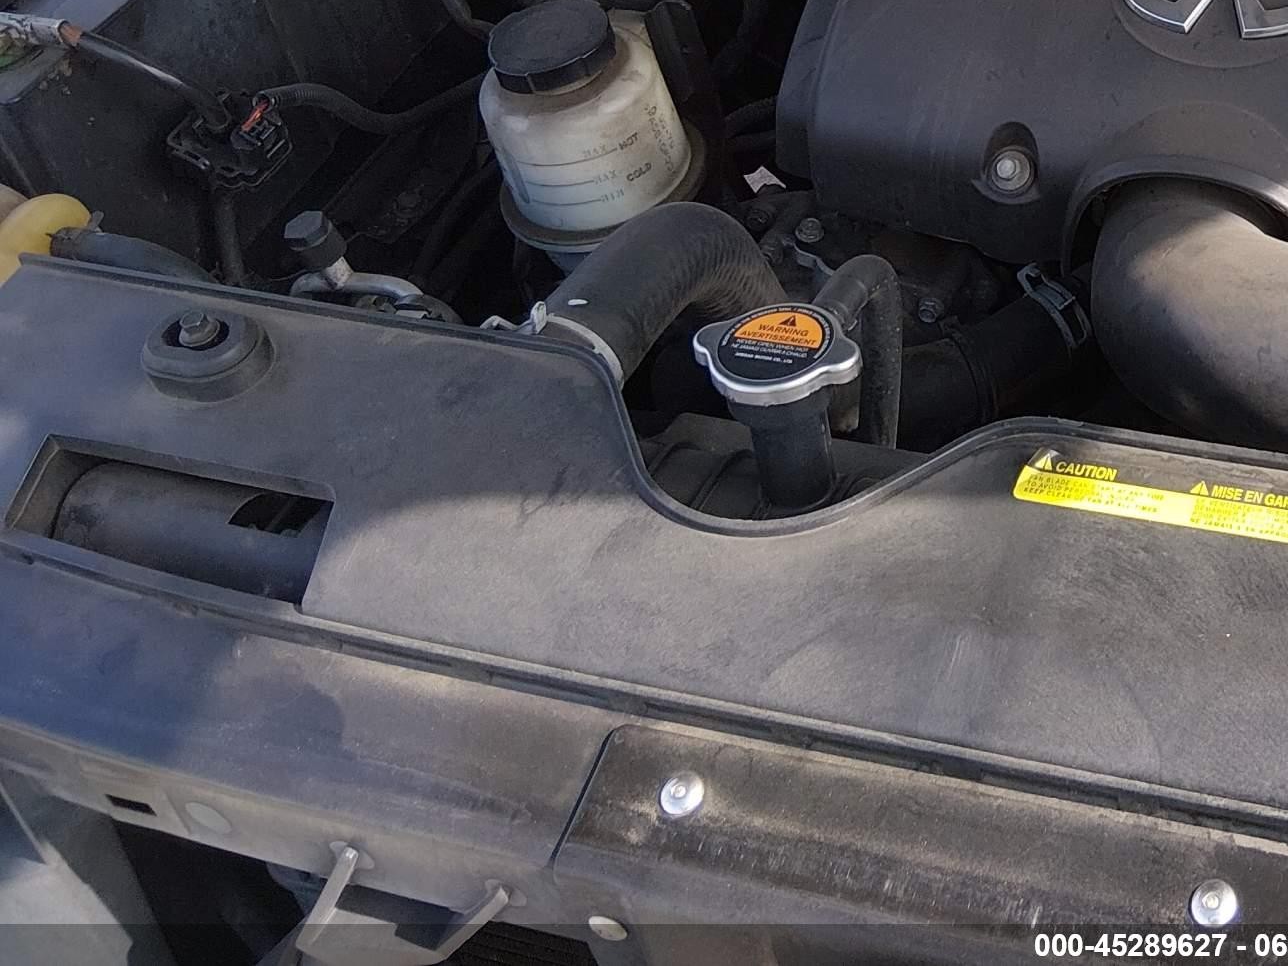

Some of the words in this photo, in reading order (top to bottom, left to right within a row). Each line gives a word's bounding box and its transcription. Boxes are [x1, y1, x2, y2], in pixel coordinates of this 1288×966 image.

[618, 132, 639, 151] HOT
[626, 161, 652, 183] COLD
[740, 330, 818, 346] AVERTISSEMENT
[758, 323, 810, 338] WARNING
[736, 338, 756, 346] NEVER
[759, 340, 774, 348] OPEN
[775, 343, 795, 351] WHEN
[795, 345, 810, 353] HOT
[1028, 472, 1044, 482] FAN
[1046, 475, 1069, 486] BLADE
[1055, 461, 1118, 482] CAUTION
[1023, 486, 1044, 496] KEEP
[1046, 489, 1071, 500] CLEAR
[1026, 479, 1036, 487] TO
[1036, 481, 1063, 492] AVOID
[1211, 485, 1244, 502] MISE
[1244, 490, 1265, 505] EN
[1203, 519, 1233, 531] JAMAIS
